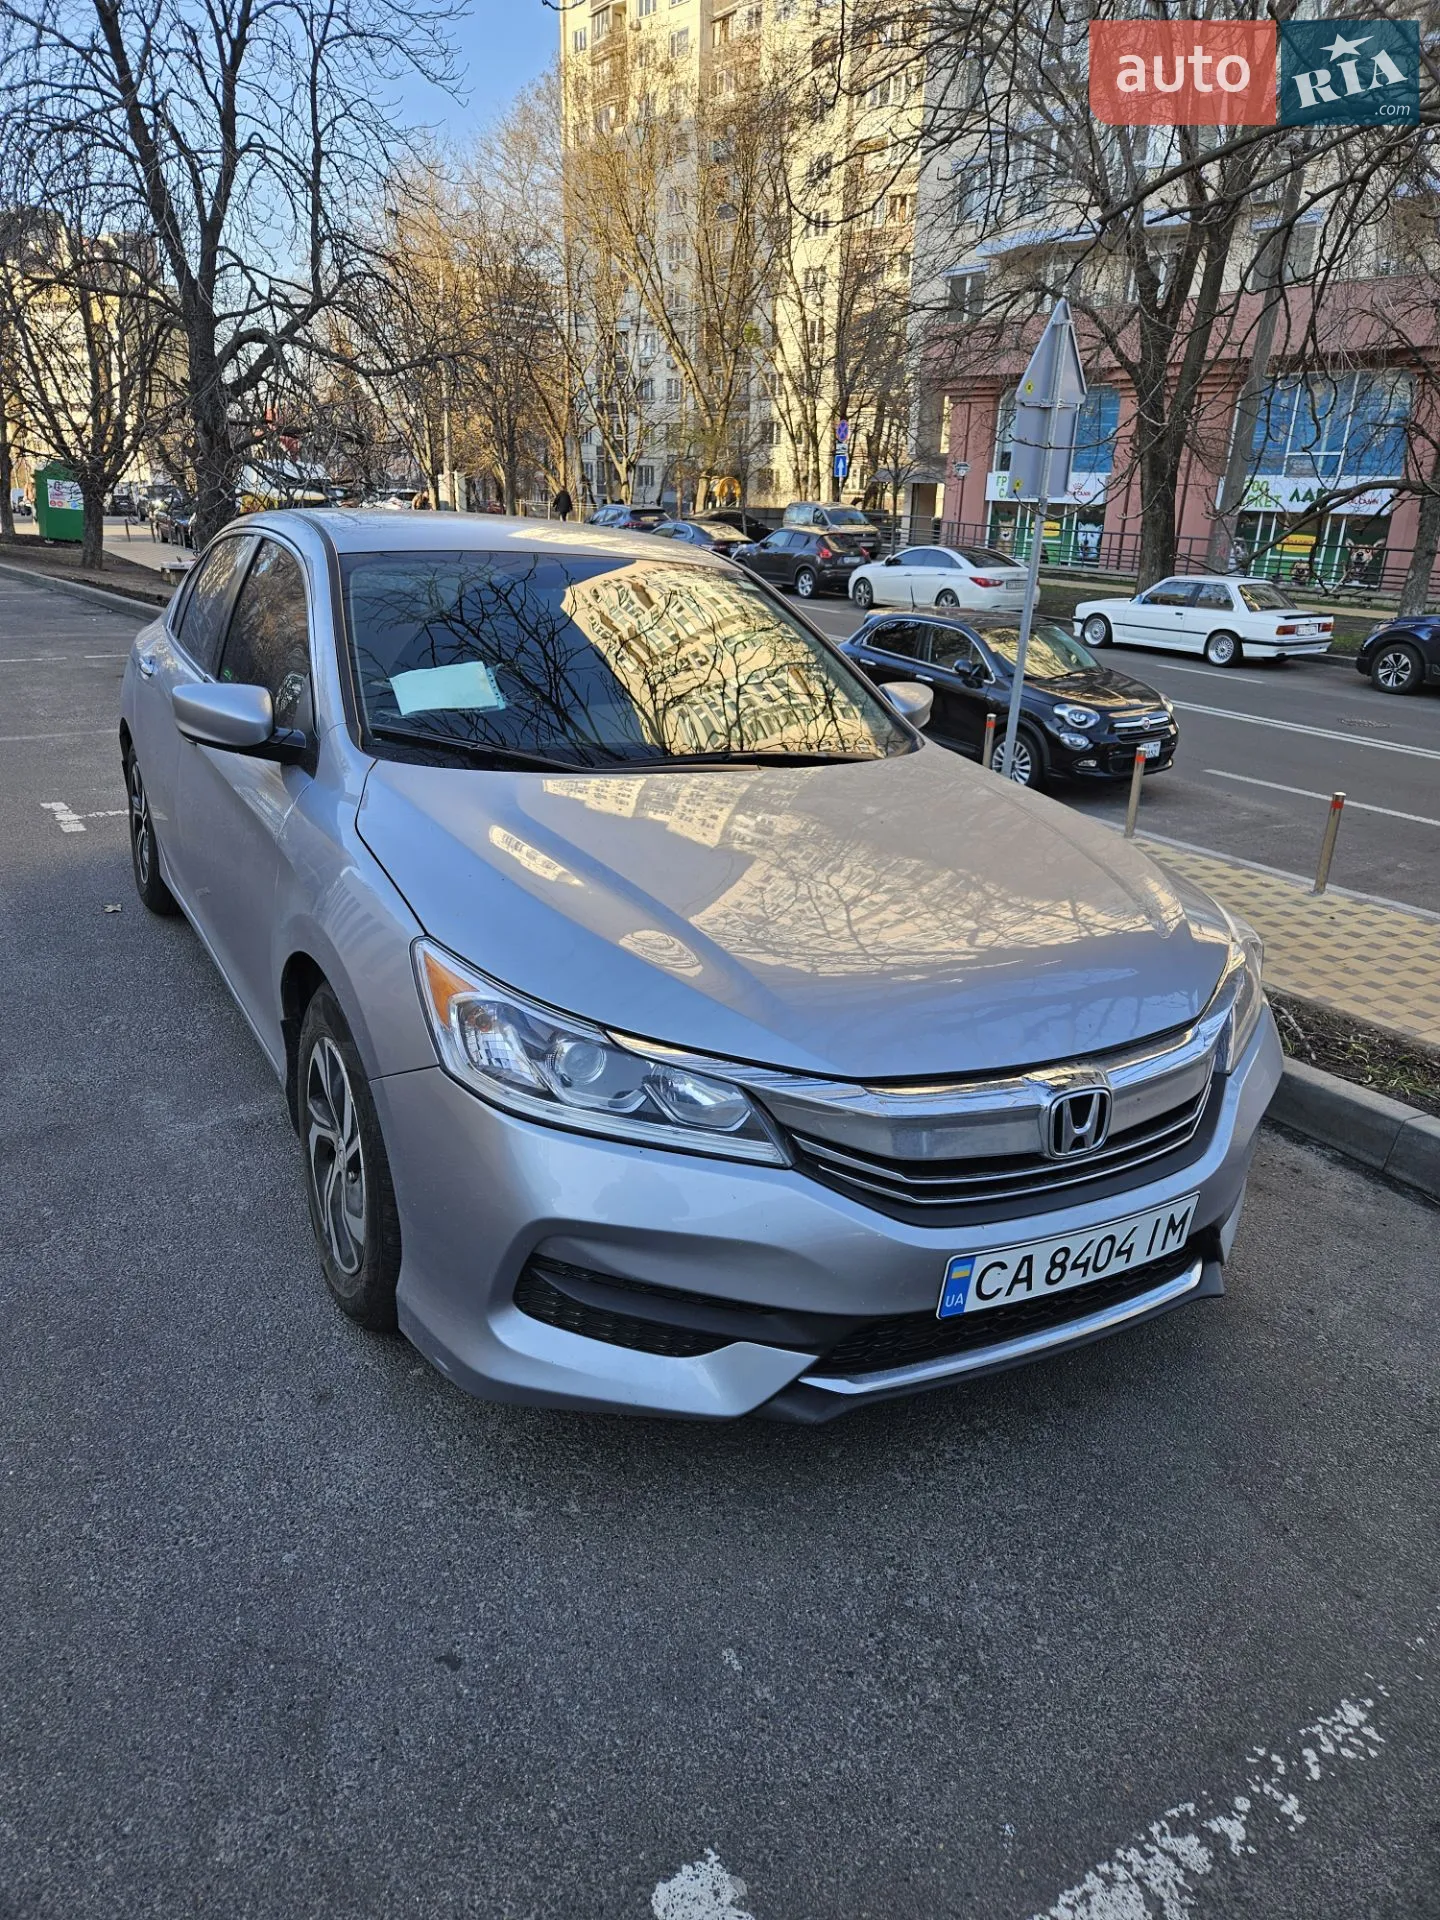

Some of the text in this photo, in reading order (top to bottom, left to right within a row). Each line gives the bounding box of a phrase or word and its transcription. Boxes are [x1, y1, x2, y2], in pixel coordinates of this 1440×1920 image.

[975, 1206, 1192, 1301] CA 8404 IM
[945, 1292, 964, 1308] UA
